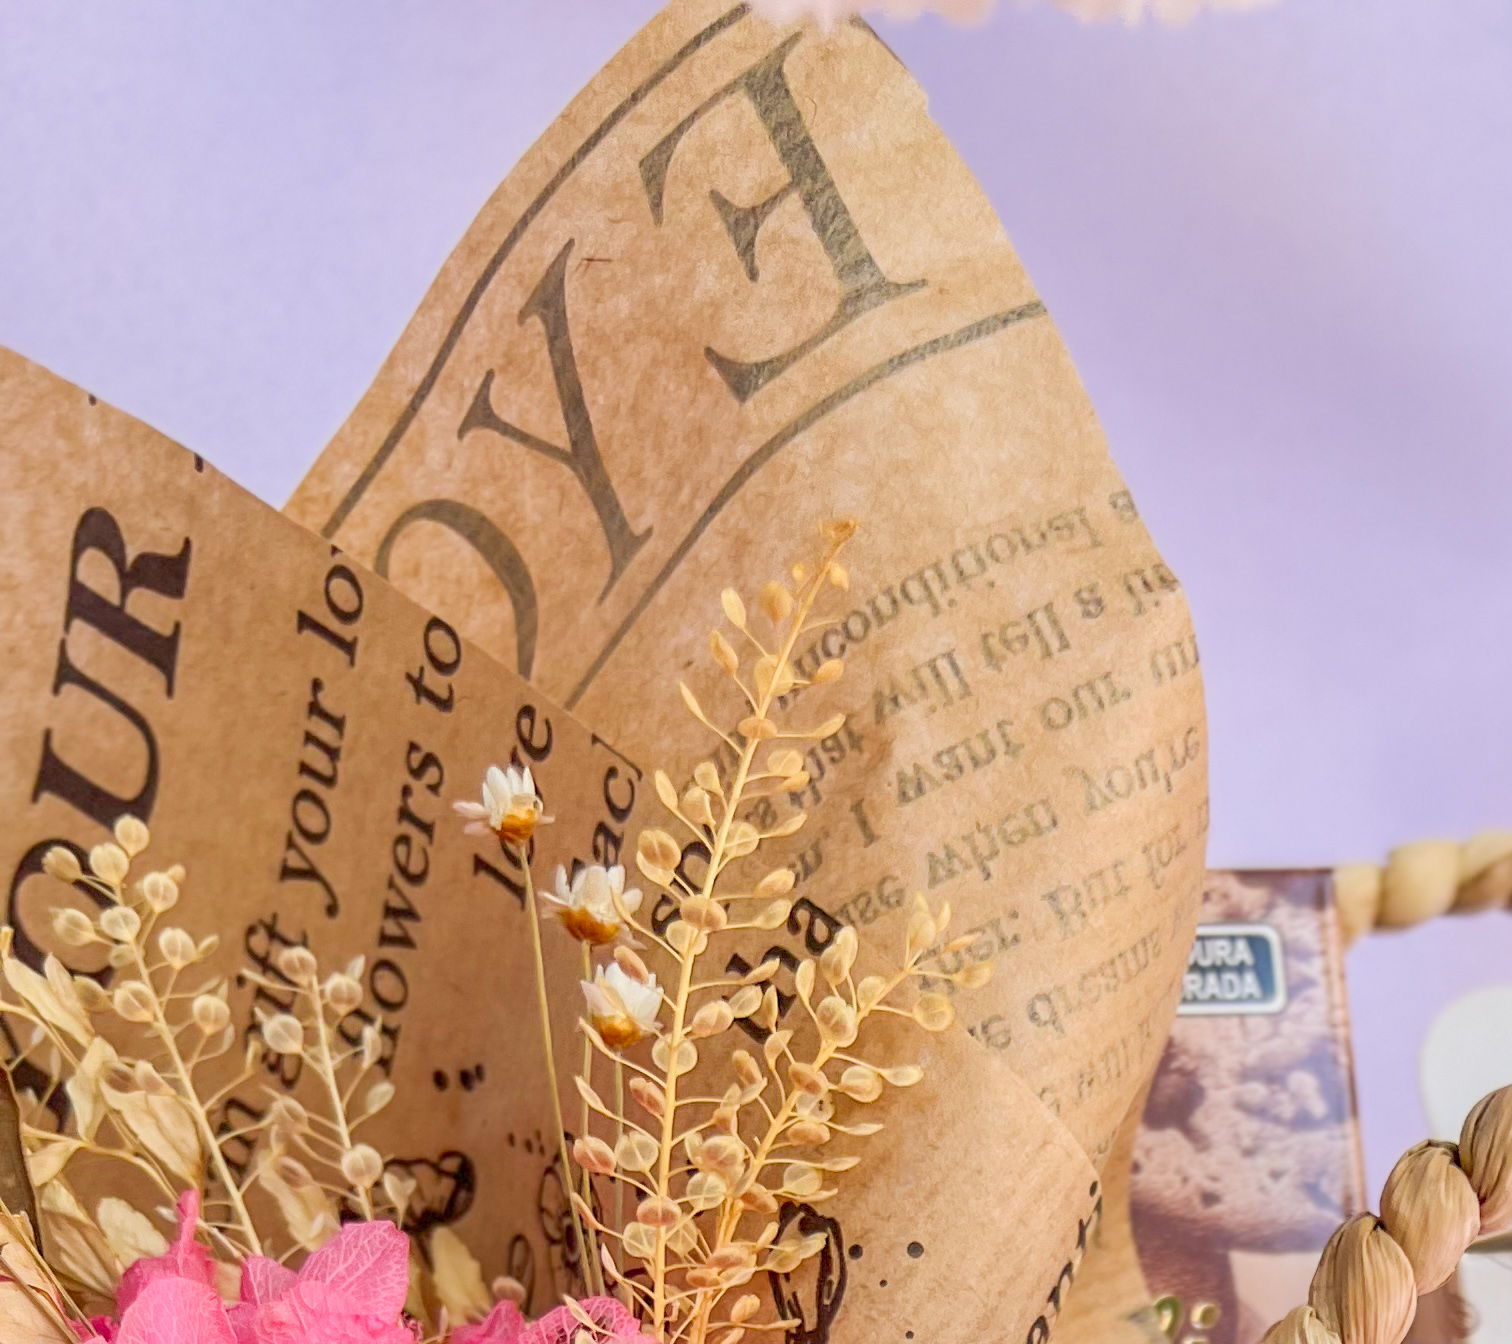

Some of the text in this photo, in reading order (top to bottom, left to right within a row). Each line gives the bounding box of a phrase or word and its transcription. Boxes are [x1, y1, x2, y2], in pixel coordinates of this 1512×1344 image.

[297, 544, 364, 668] lo
[405, 615, 462, 713] to
[280, 678, 346, 919] your
